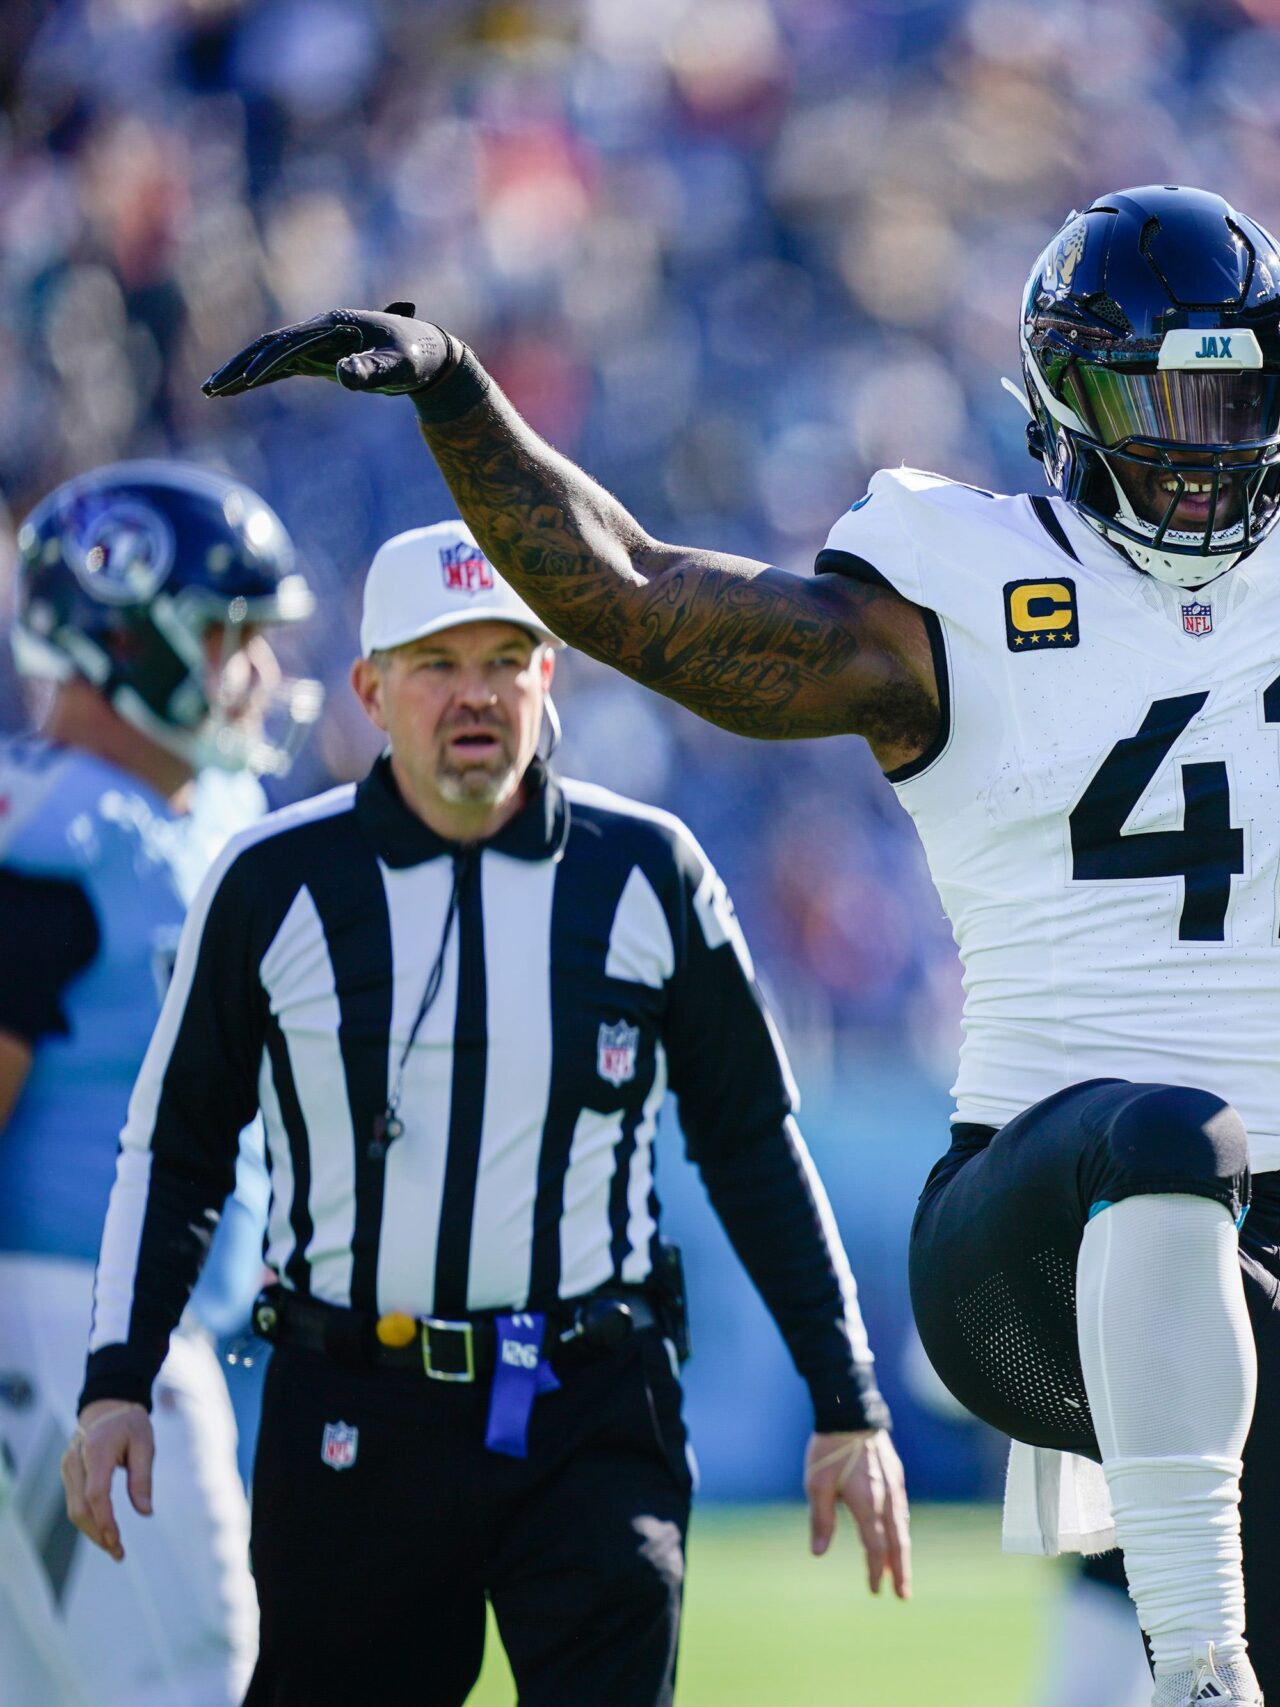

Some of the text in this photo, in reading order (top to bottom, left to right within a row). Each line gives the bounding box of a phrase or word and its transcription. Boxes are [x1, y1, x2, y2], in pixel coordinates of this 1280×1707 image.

[1195, 336, 1232, 359] JAX
[446, 560, 494, 592] NFL
[1010, 583, 1072, 632] C
[1185, 616, 1210, 633] NFL
